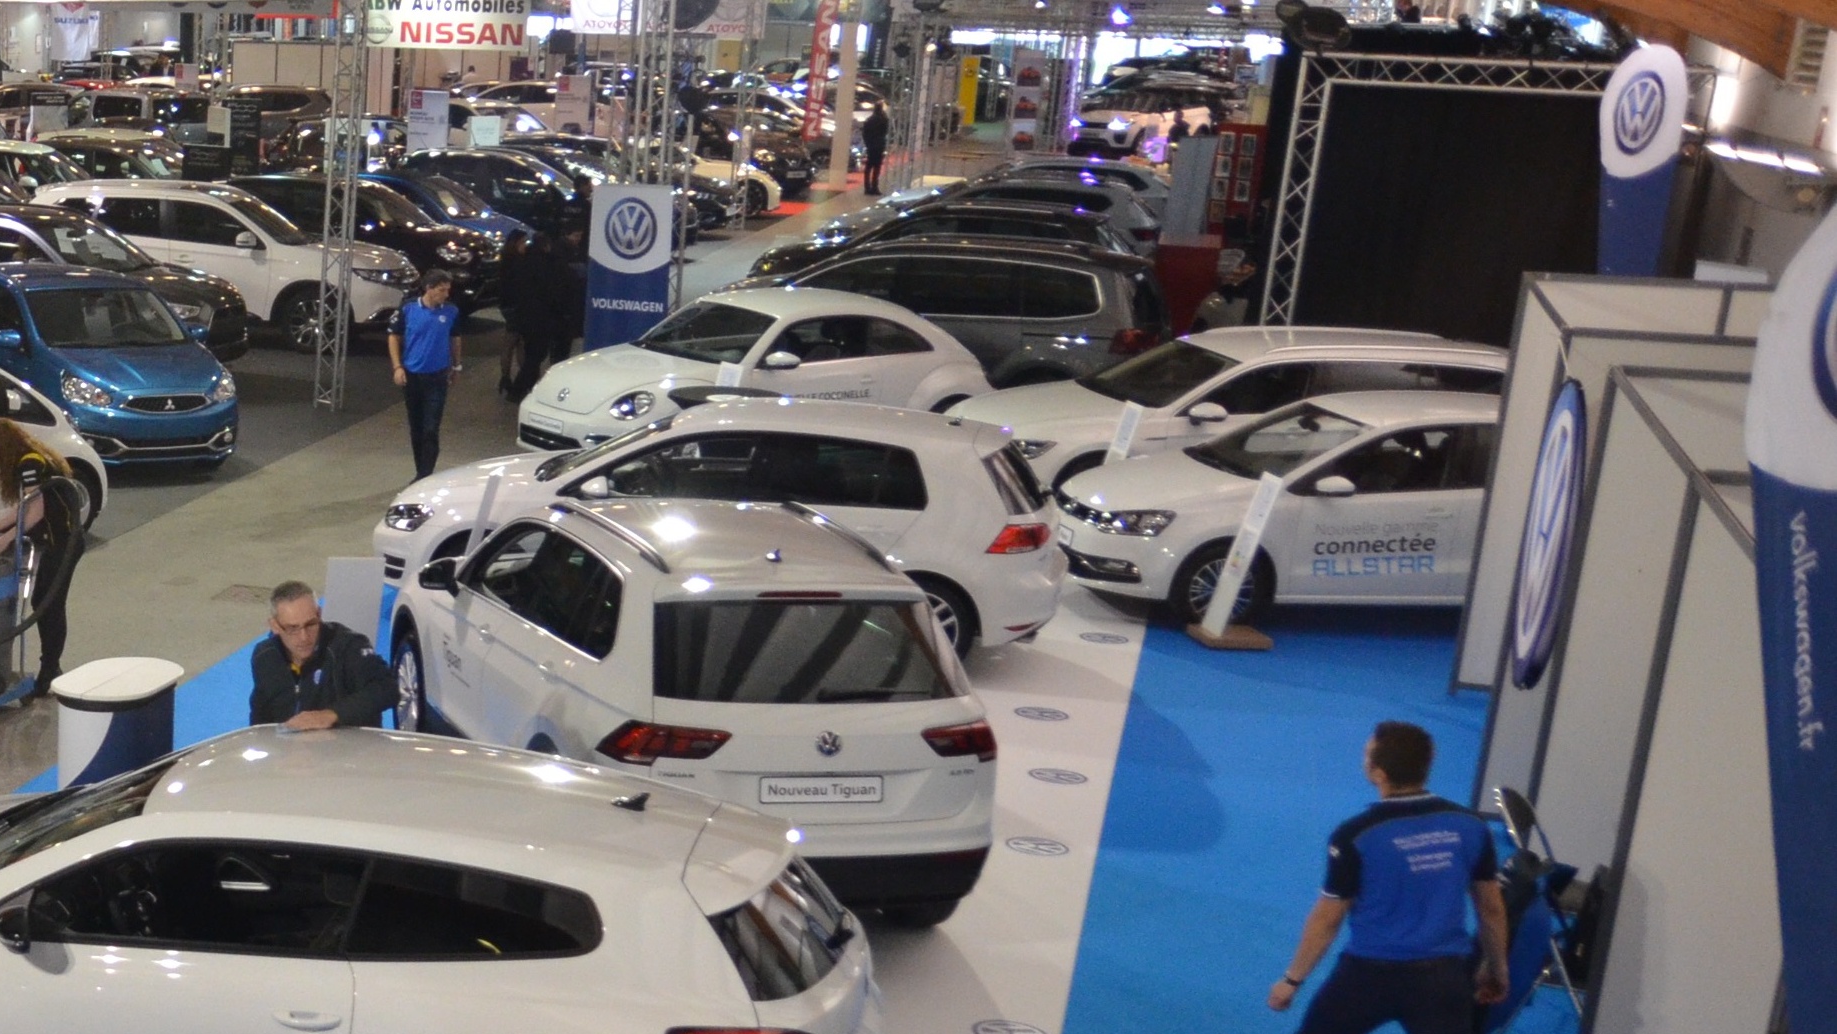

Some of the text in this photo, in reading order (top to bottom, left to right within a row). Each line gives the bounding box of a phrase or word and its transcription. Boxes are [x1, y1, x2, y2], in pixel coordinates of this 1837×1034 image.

[412, 0, 524, 14] Automobiles
[400, 21, 523, 46] NISSAN
[592, 297, 663, 313] VOLKSWAGEN
[819, 388, 871, 400] COCCINELLE
[1315, 521, 1378, 536] Nouvelle
[1314, 533, 1437, 555] connectée
[1313, 555, 1435, 577] ALLSTAR
[1790, 509, 1824, 749] volkswagen.fr
[768, 782, 877, 799] Nouveau Tiguan
